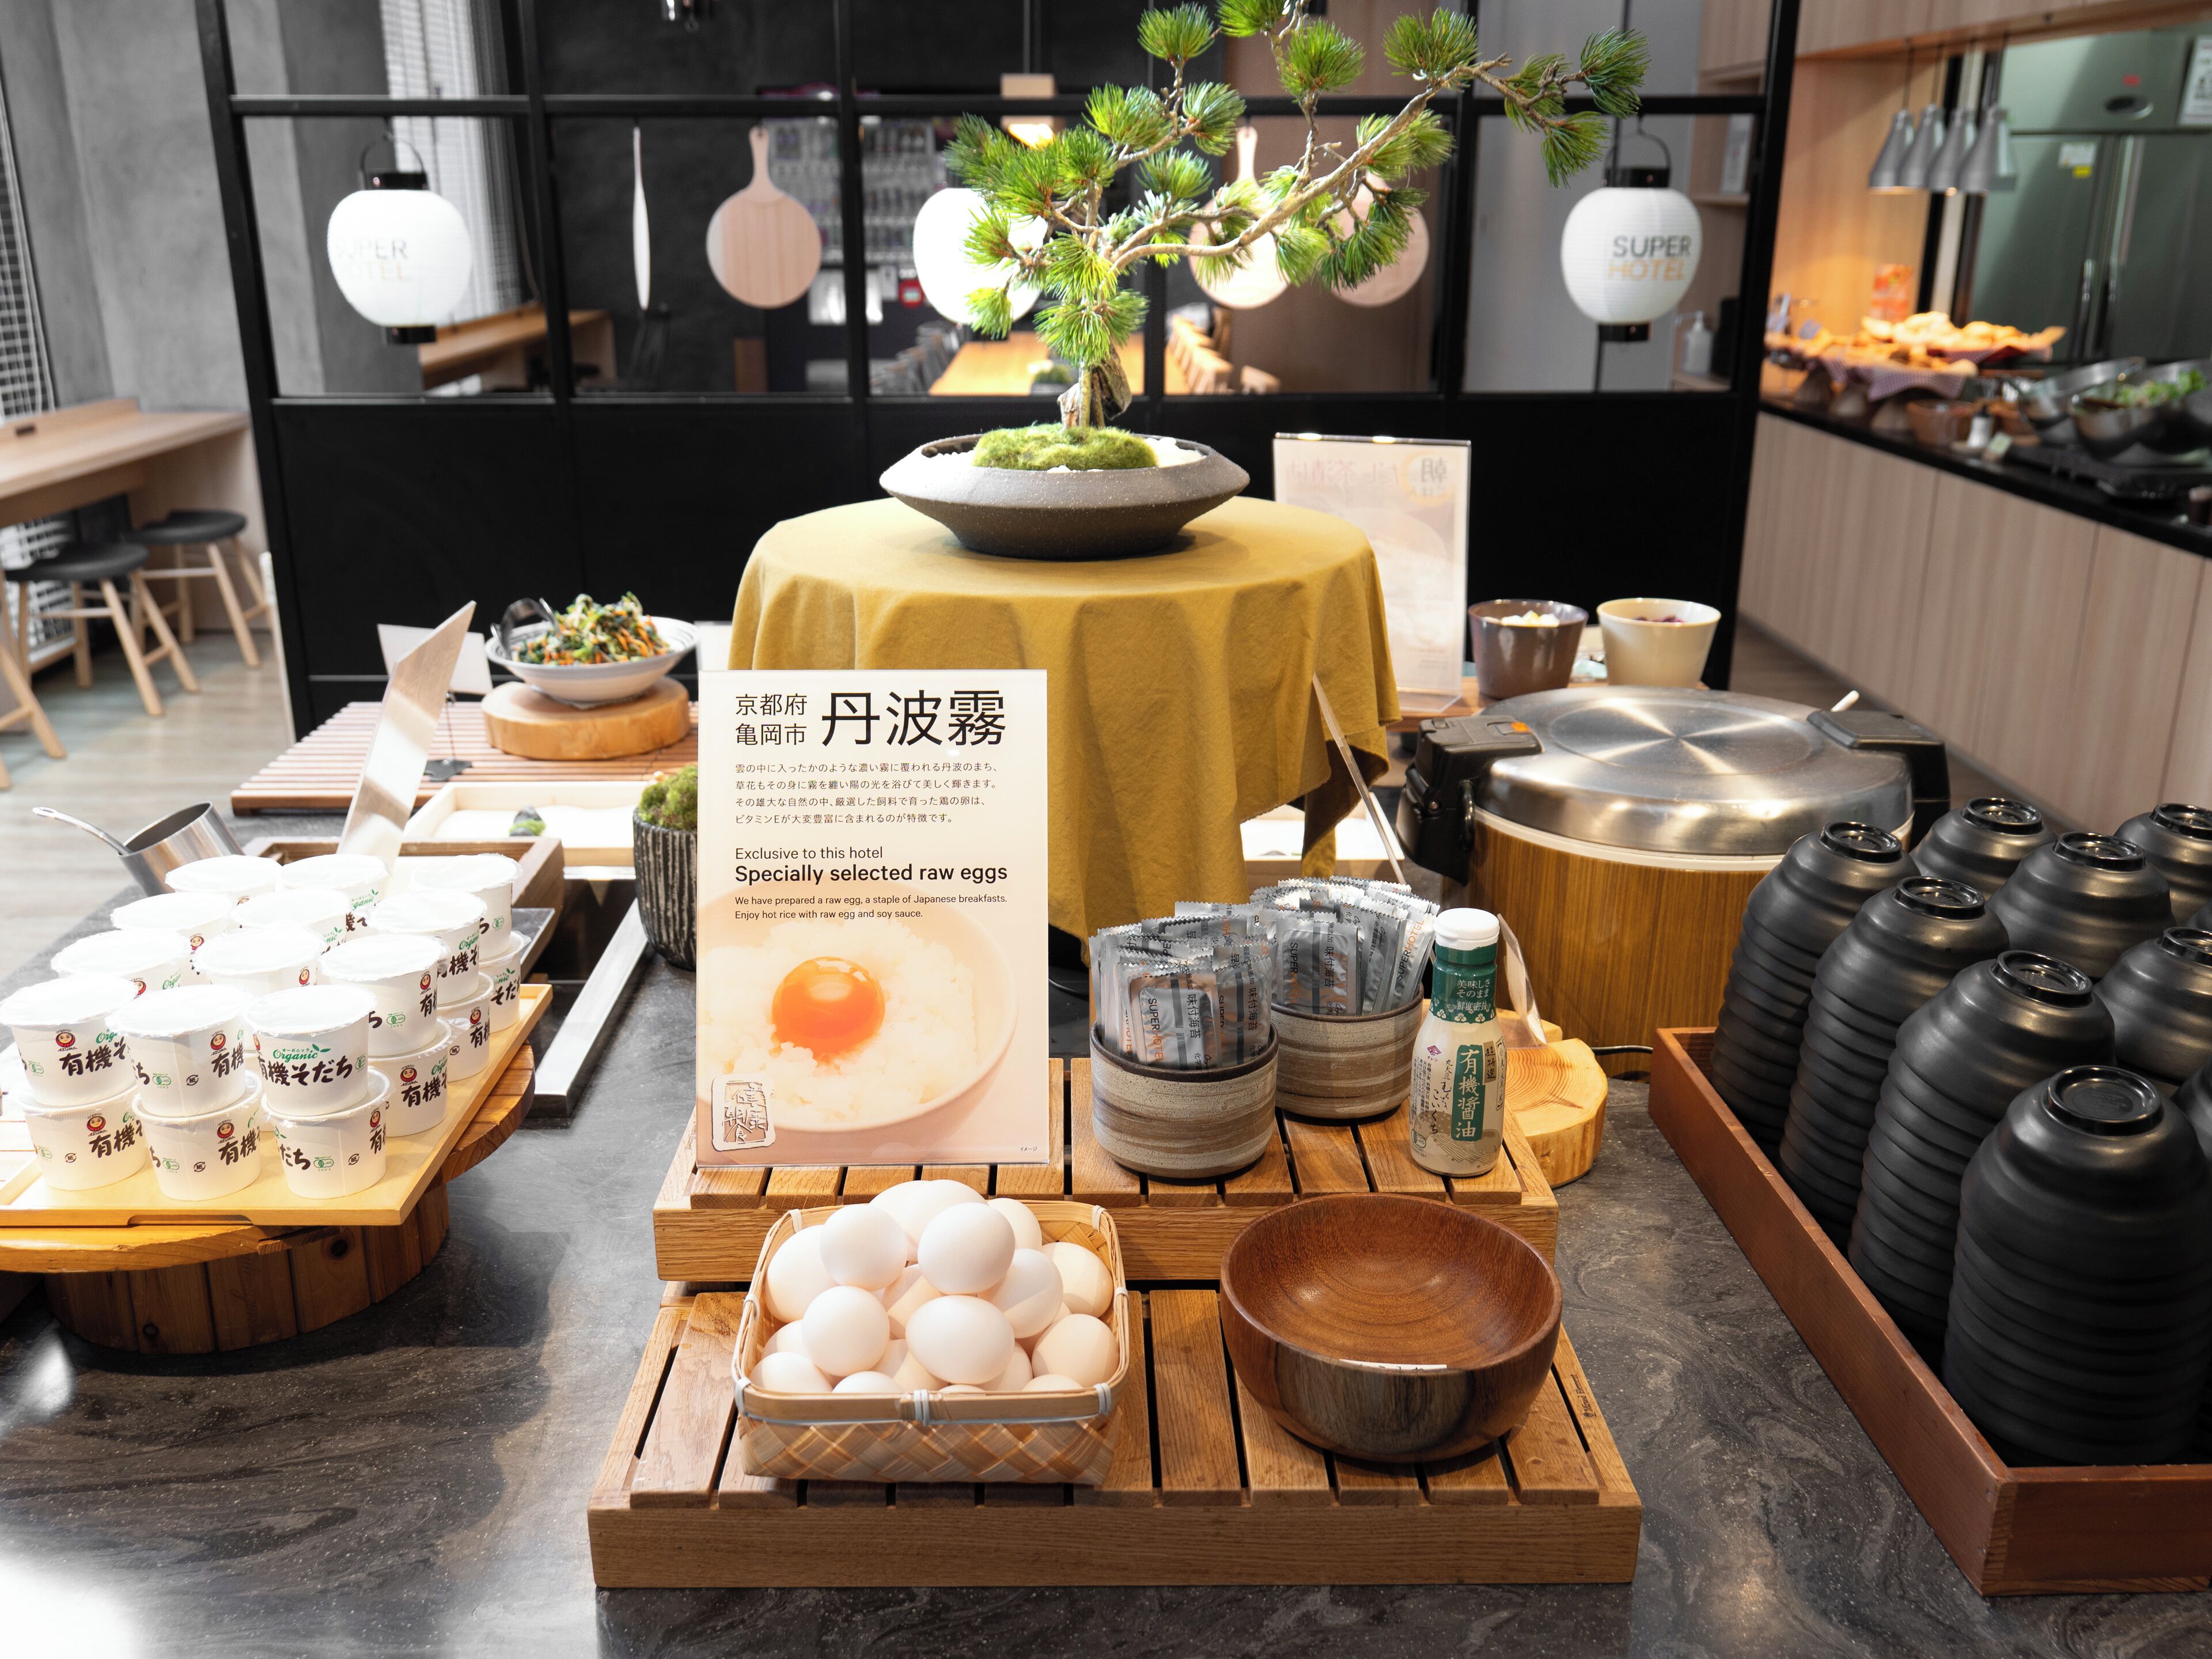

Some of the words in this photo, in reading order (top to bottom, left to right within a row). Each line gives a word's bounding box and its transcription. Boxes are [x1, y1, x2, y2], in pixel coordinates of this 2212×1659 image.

[336, 238, 408, 260] UPER
[1612, 235, 1692, 258] SUPER
[1608, 258, 1685, 281] HOTEL
[735, 694, 808, 717] 京都府
[821, 690, 1006, 747] 丹波霧
[735, 723, 808, 746] 亀岡市
[735, 762, 997, 774] 雲の中に入ったかのような濃い霧に覆われる丹波のまち、
[735, 779, 996, 790] 草花もその身に霧を纏い陽の光を浴びて美しく輝きます。
[735, 796, 986, 807] その雄大な自然の中、厳選した飼料で育った鶏の卵は、
[736, 813, 952, 824] ビタミンEが大変豊富に含まれるのが特徴です。
[736, 847, 798, 859] Exclusive
[803, 849, 816, 859] to
[820, 847, 845, 858] this
[850, 846, 883, 858] hotel
[736, 864, 824, 885] Specially
[830, 863, 912, 881] selected
[920, 868, 954, 880] raw
[961, 868, 1007, 884] eggs
[752, 896, 772, 904] have
[775, 896, 815, 906] prepared
[844, 897, 863, 906] egg,
[873, 896, 900, 905] staple
[902, 895, 911, 903] of
[914, 895, 956, 904] Japanese
[959, 894, 1007, 903] breakfasts.
[735, 911, 760, 920] Enjoy
[779, 910, 796, 918] rice
[799, 910, 817, 918] with
[839, 911, 855, 920] egg
[858, 910, 874, 918] and
[877, 911, 892, 919] soy
[1324, 946, 1335, 988] 味付海苔
[1456, 979, 1490, 989] 美味しさ
[1456, 988, 1490, 998] そのまま
[1186, 994, 1202, 1039] 味付海苔
[1247, 987, 1258, 1031] 味付海苔
[273, 1049, 318, 1063] Organic
[259, 1055, 353, 1086] 有機そだち
[1456, 1048, 1480, 1139] 有機醤油
[218, 1126, 260, 1166] 有機
